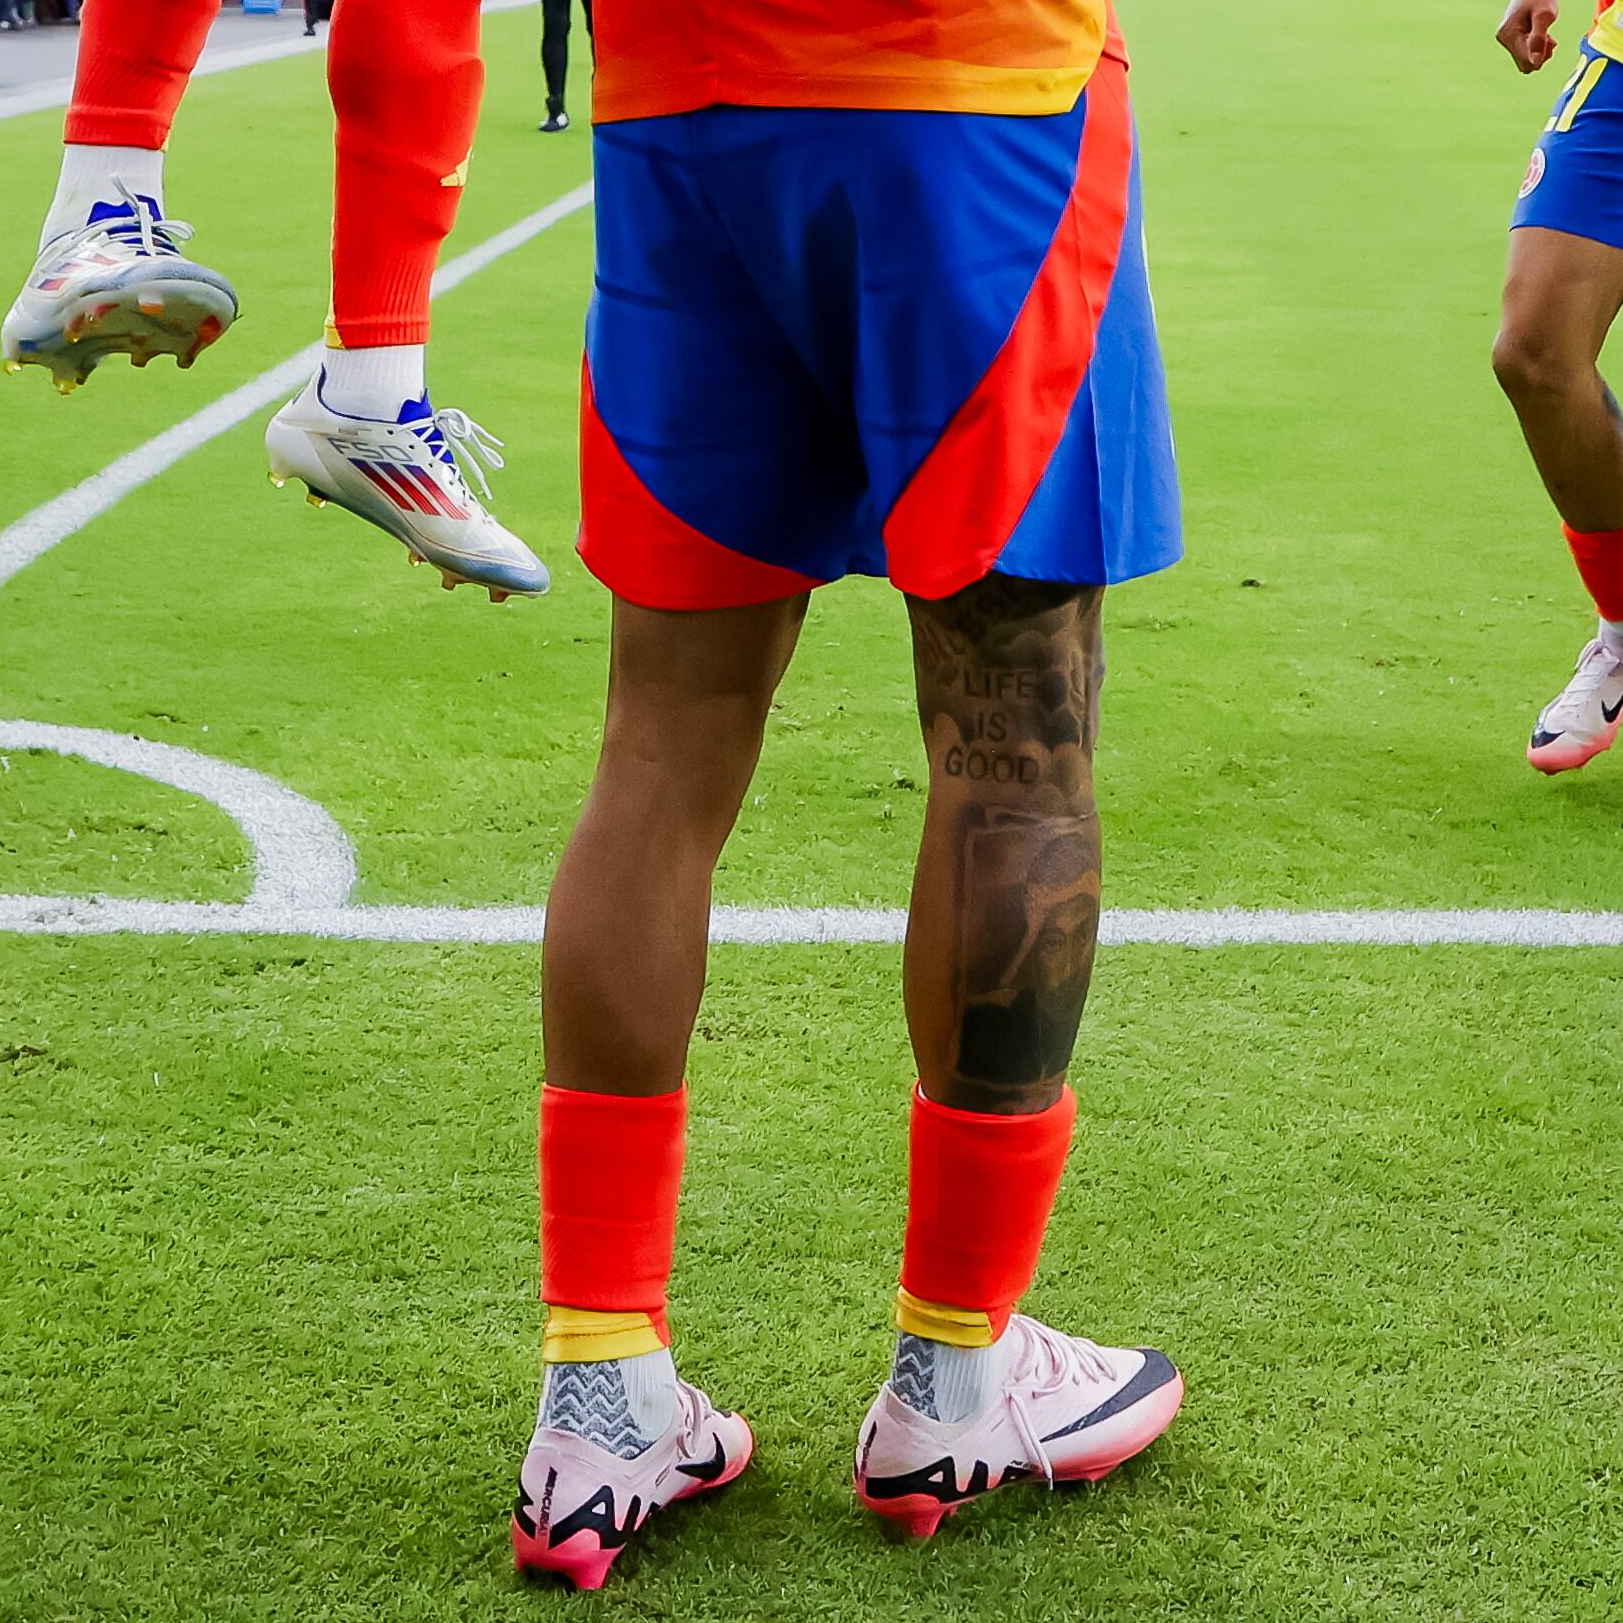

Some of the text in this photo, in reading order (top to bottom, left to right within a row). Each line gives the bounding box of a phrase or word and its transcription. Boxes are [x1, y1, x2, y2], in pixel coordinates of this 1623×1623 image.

[964, 669, 1034, 699] LIFE
[976, 712, 1008, 742] IS
[946, 745, 1040, 785] GOOD
